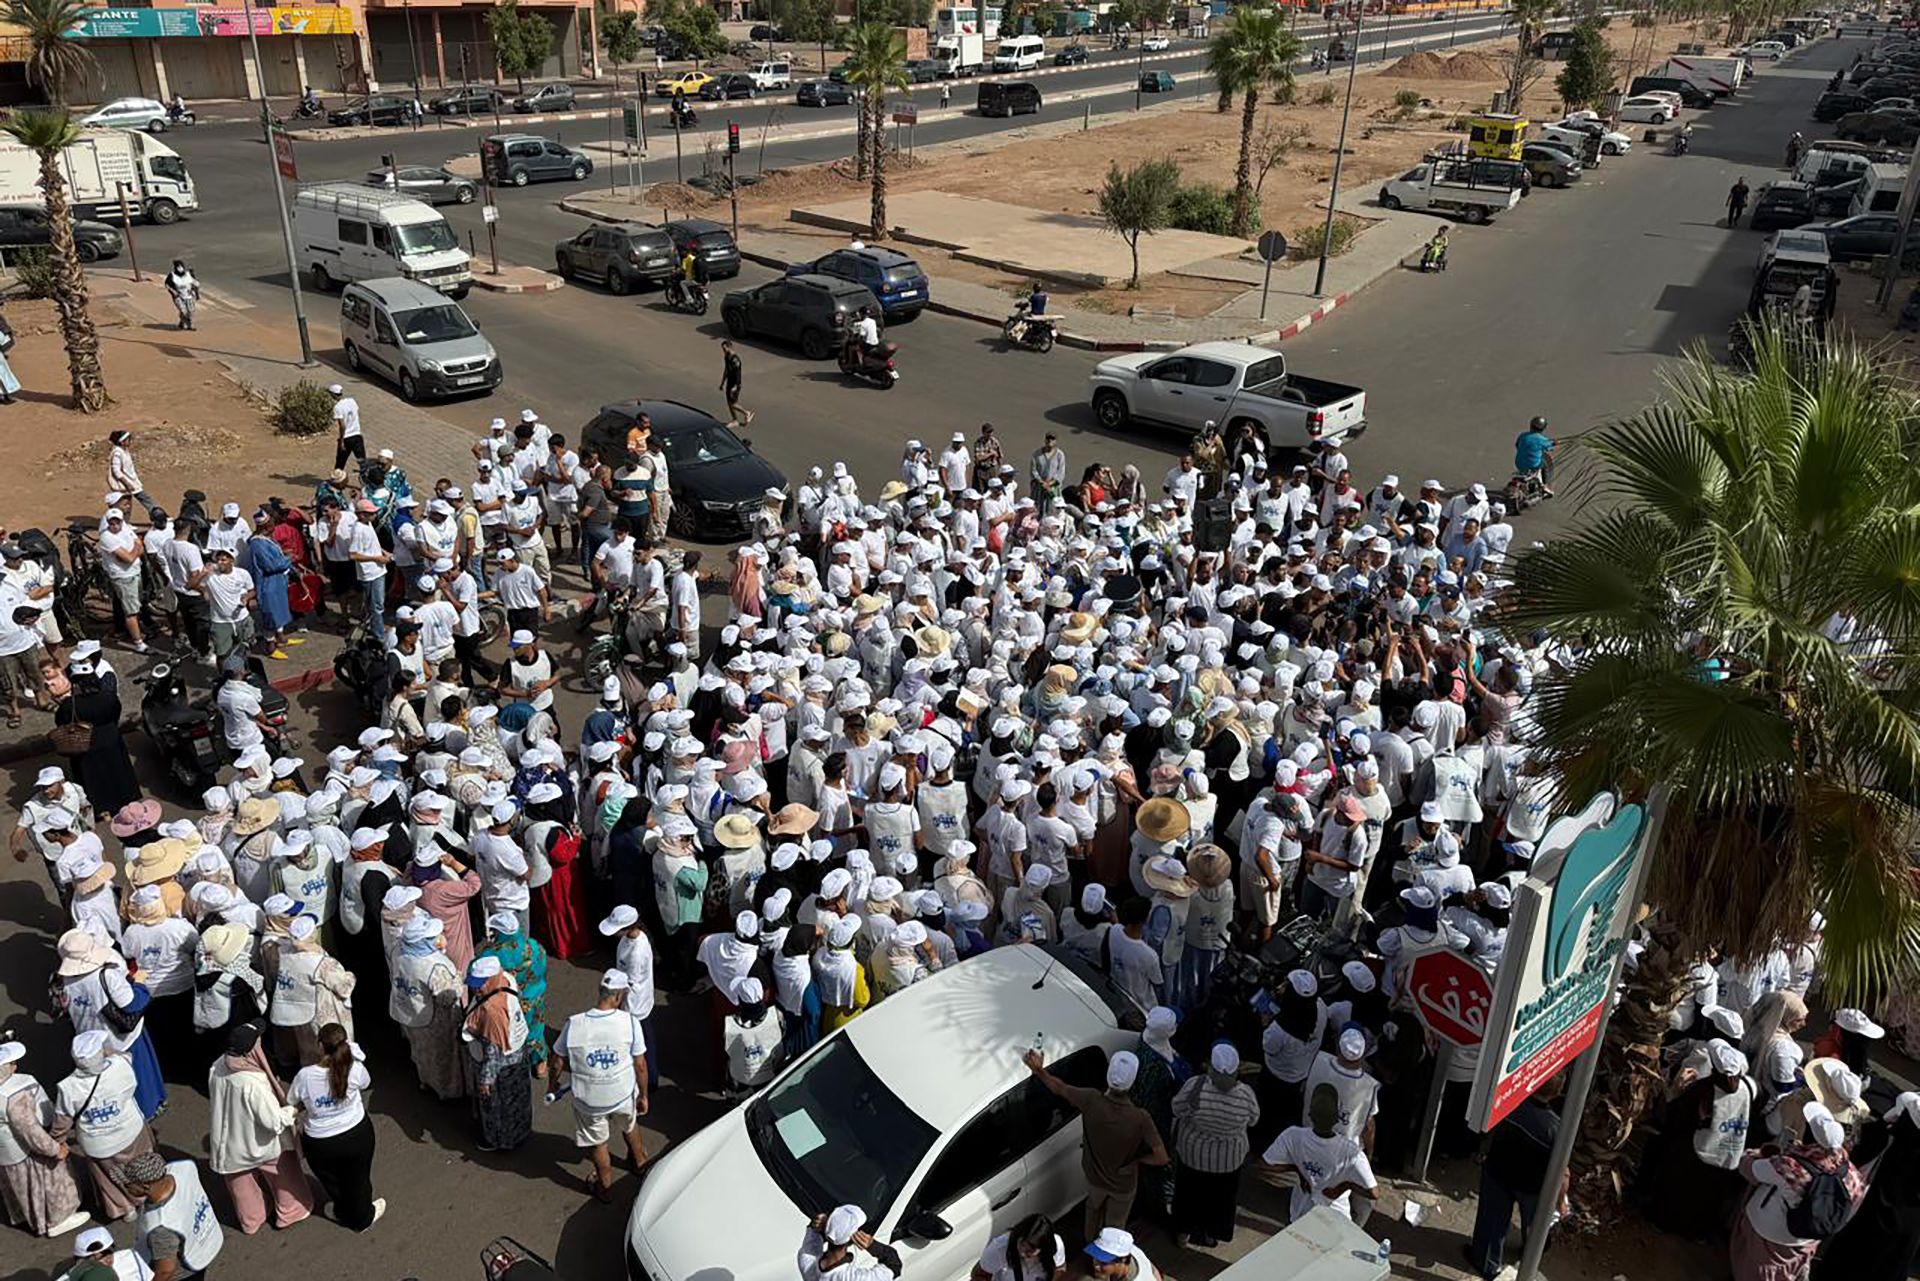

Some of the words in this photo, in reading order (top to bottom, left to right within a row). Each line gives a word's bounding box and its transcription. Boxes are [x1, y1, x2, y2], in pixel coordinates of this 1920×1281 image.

[1418, 976, 1489, 1038] قف
[1520, 1006, 1559, 1044] CENTRE
[1559, 970, 1605, 1014] DENTAIRE
